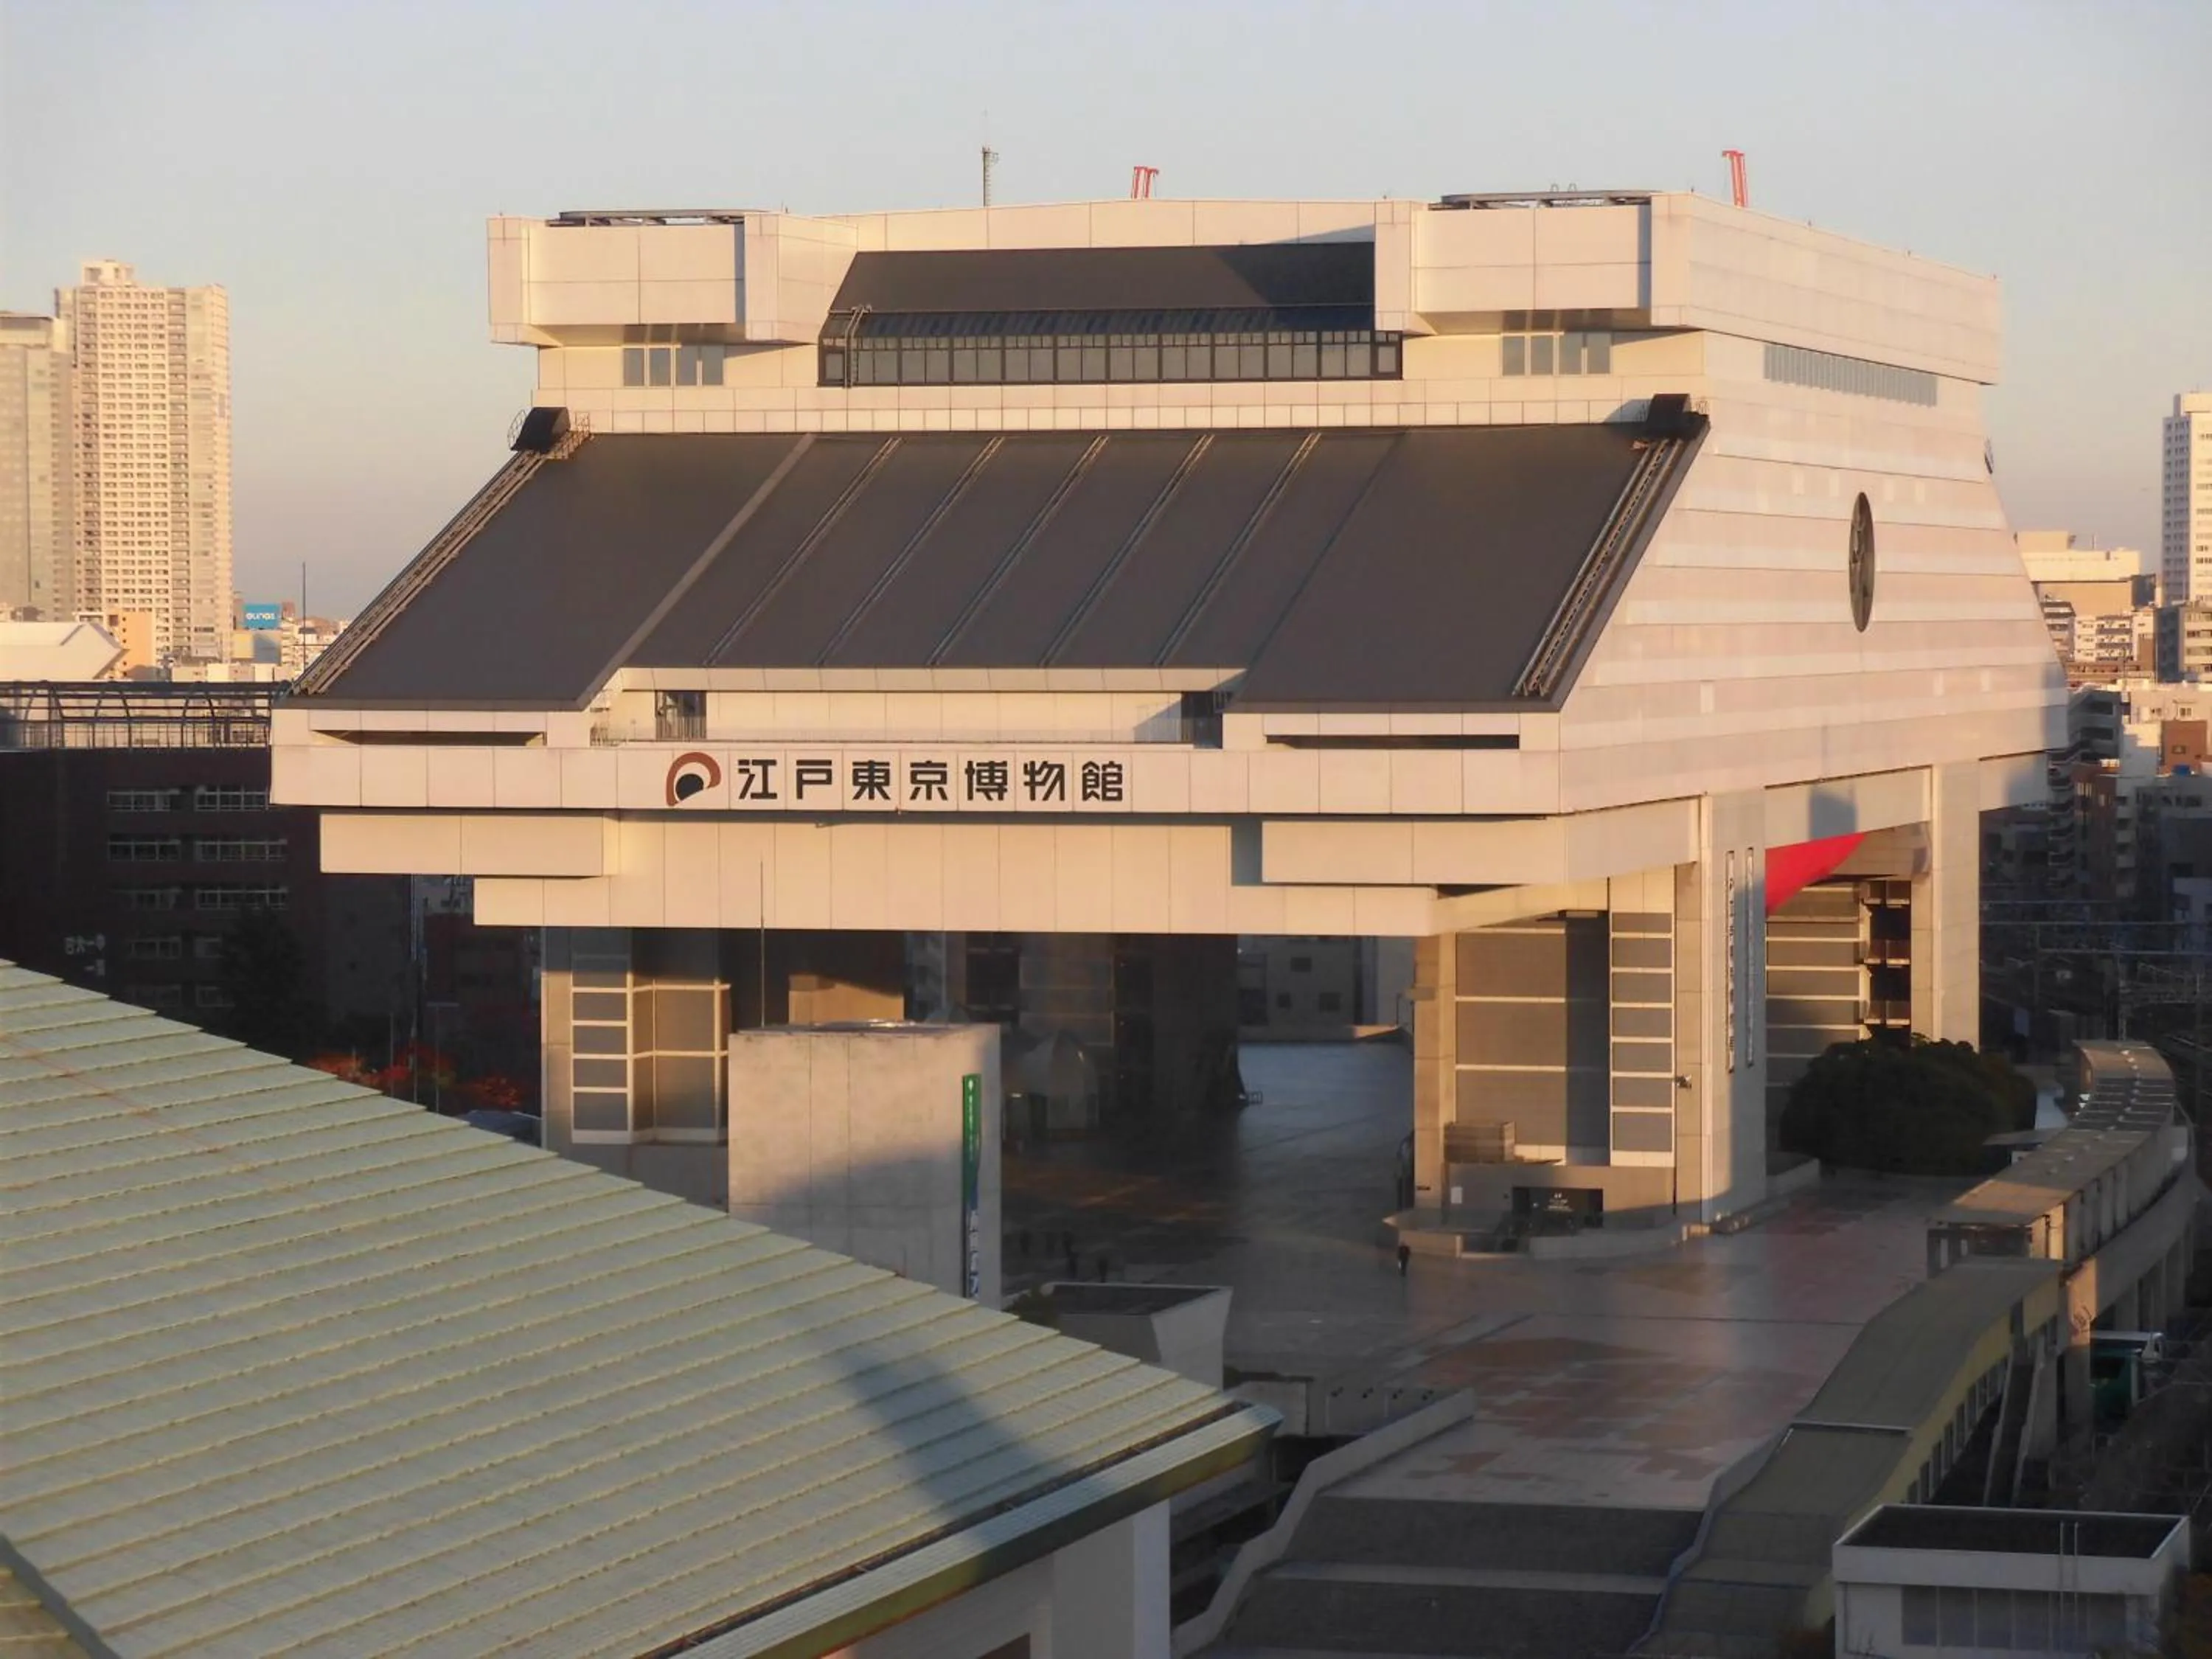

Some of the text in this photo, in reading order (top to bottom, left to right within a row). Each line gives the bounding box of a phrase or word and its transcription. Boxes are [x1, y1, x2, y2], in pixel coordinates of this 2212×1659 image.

[738, 759, 1123, 801] 江戸東京博物館
